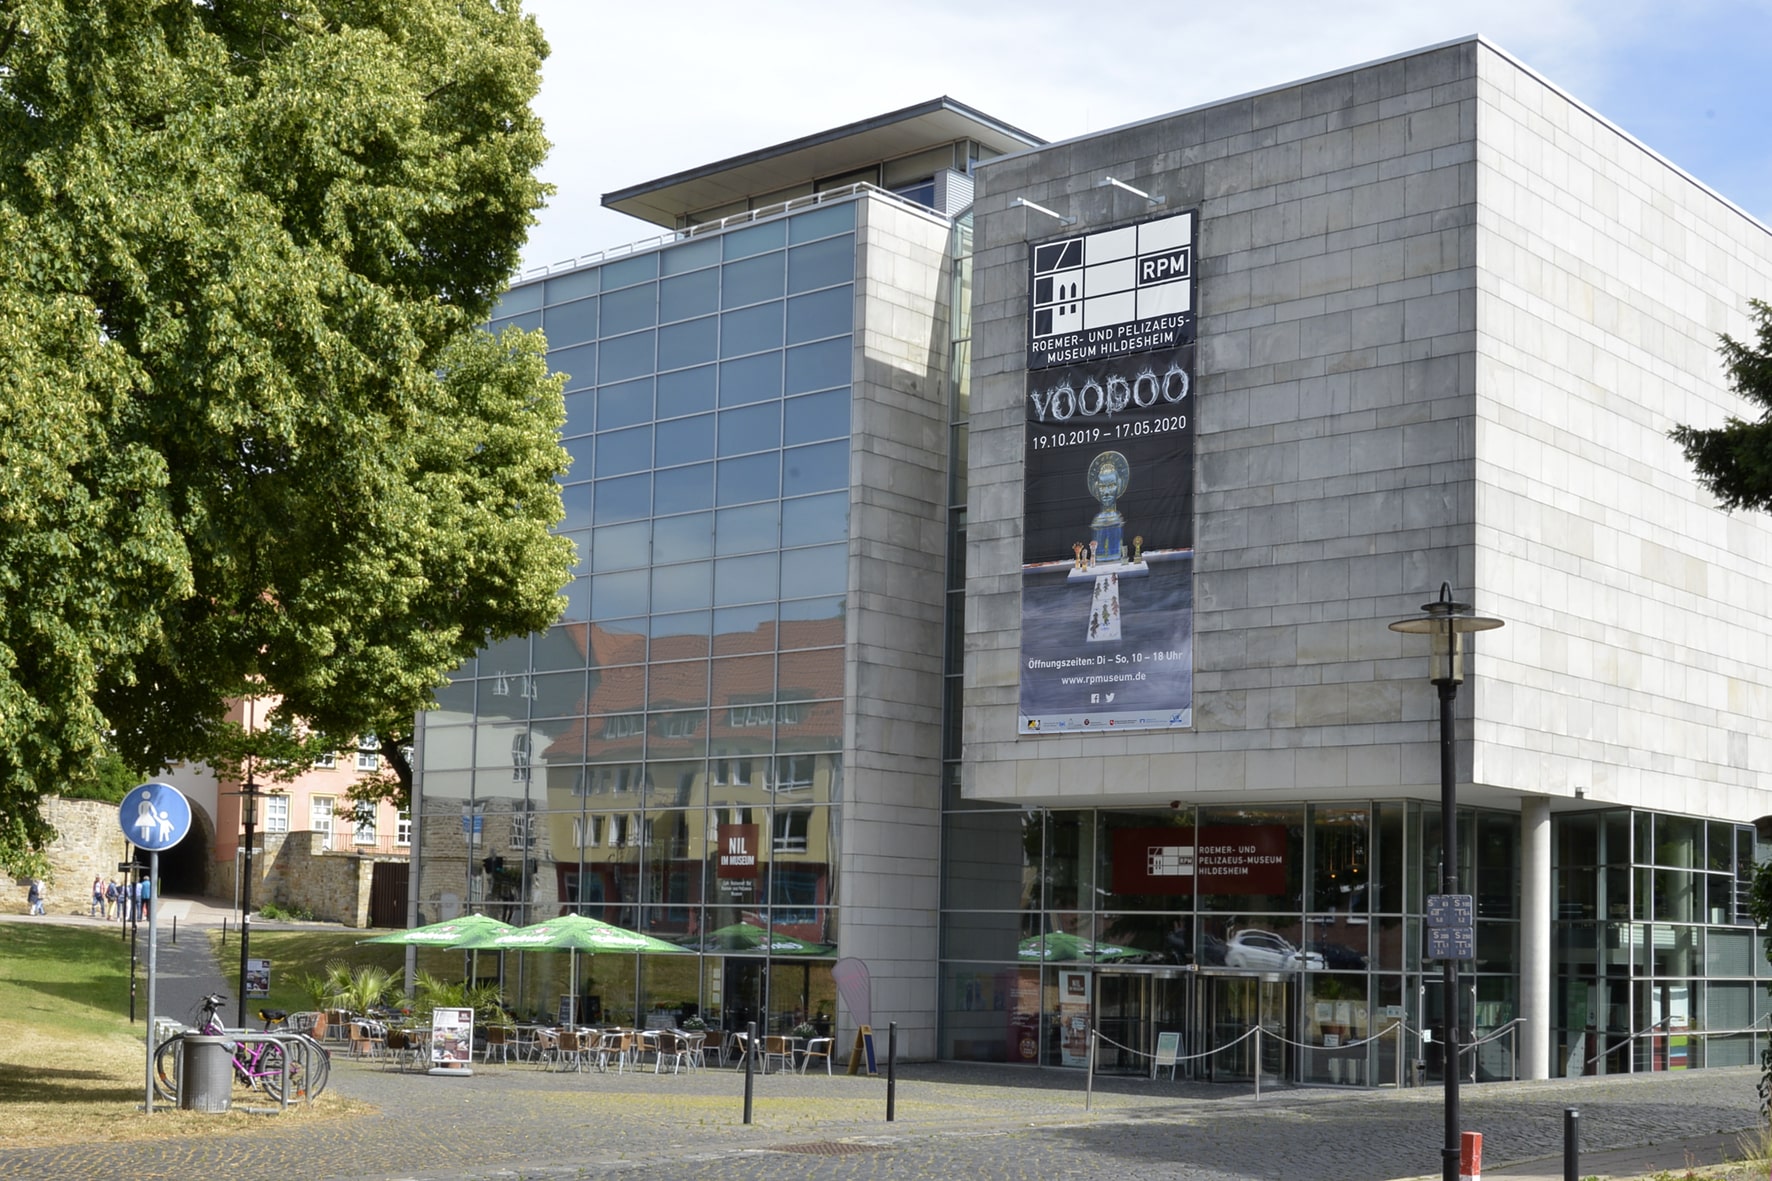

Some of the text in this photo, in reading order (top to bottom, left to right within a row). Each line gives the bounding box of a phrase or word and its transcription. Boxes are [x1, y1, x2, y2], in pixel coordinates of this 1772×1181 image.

[1143, 254, 1185, 280] RPM
[1032, 315, 1190, 352] ROEMER- UND PELIZAEUS-
[1047, 332, 1174, 363] MUSEUM HILDESHEIM
[1031, 362, 1189, 422] VOODOO
[1032, 428, 1100, 450] 19.10.2019
[1115, 415, 1187, 438] 17.05.2020
[1028, 656, 1095, 669] Öffnungszeiten:
[1097, 655, 1106, 665] Di
[1115, 654, 1129, 664] So,
[1132, 653, 1143, 662] 10
[1153, 652, 1164, 661] 18
[1166, 651, 1183, 661] Uhr
[1061, 672, 1146, 685] www.rpmuseum.de
[729, 837, 748, 854] NIL
[1199, 845, 1256, 854] ROEMER- UND
[721, 855, 755, 865] IM MUSEUM
[1199, 856, 1282, 865] PELIZAEUS-MUSEUM
[1199, 867, 1249, 875] HILDESHEIM
[1433, 931, 1439, 939] S
[1455, 931, 1461, 939] S
